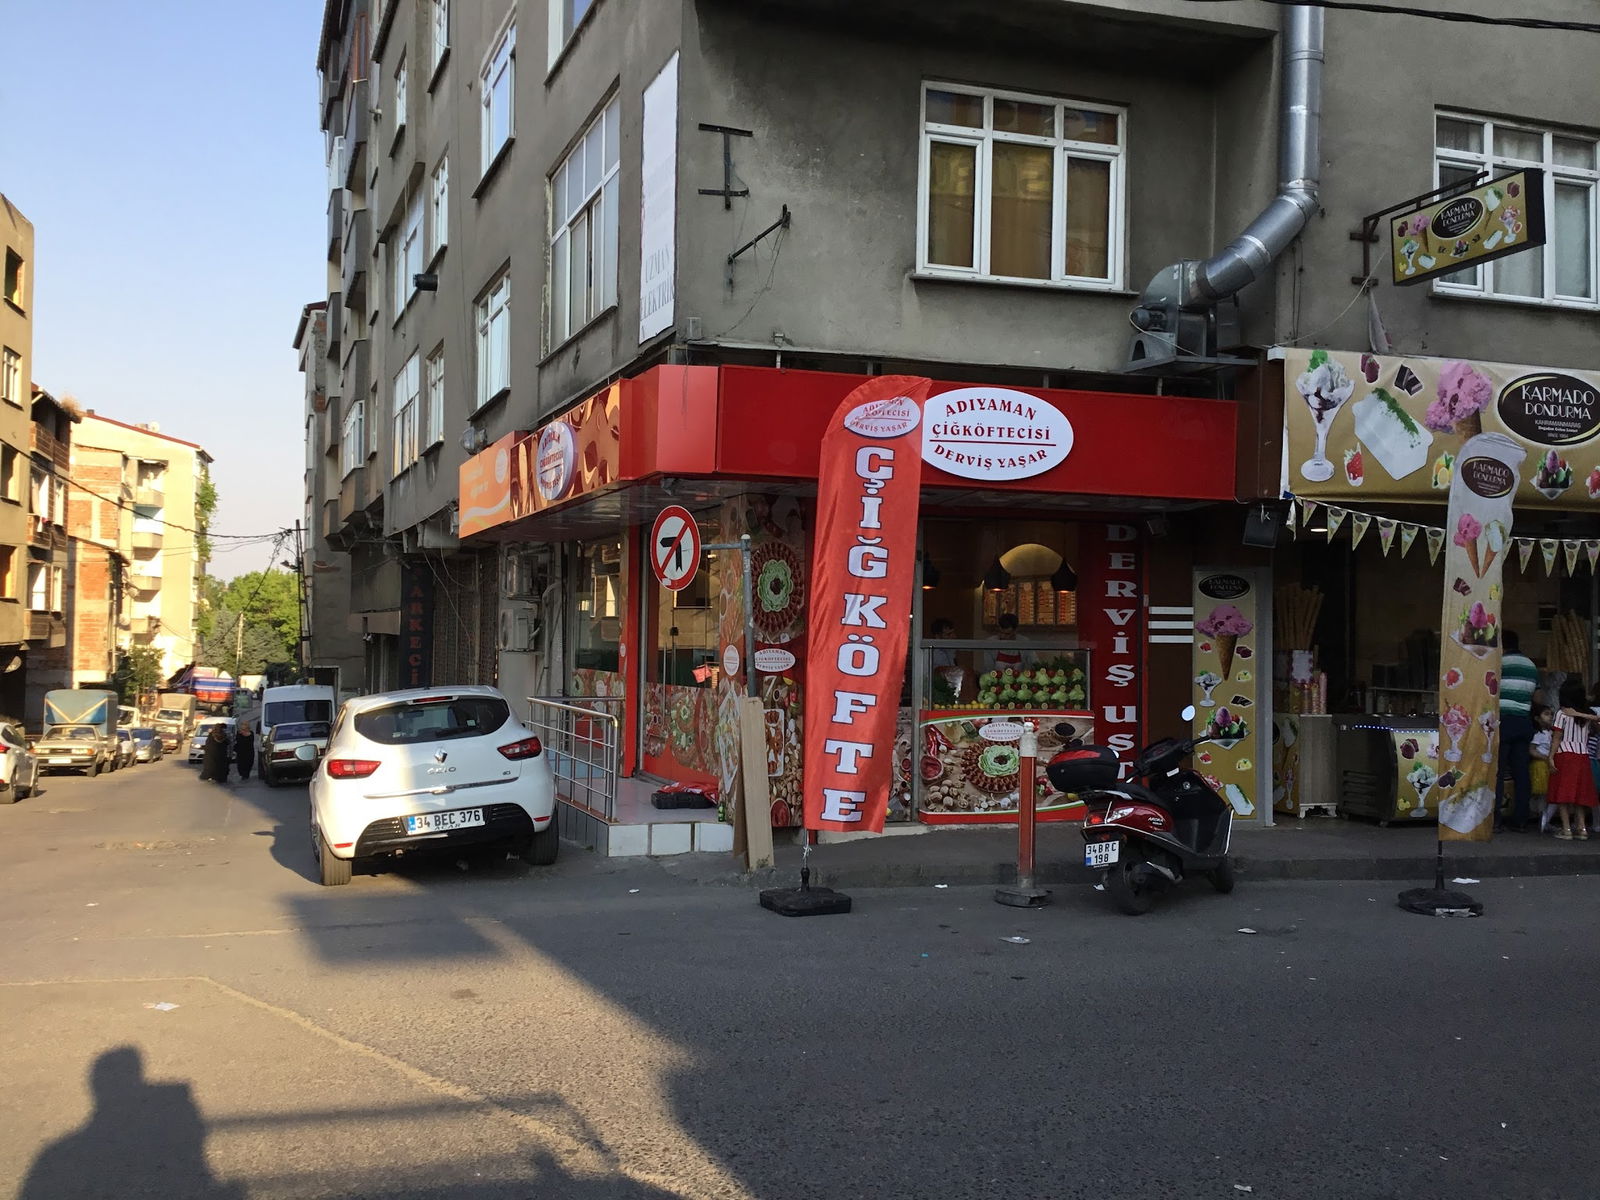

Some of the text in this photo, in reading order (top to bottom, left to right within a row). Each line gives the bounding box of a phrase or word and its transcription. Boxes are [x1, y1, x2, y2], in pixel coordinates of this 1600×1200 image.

[1521, 385, 1595, 406] KARMADO
[945, 398, 1037, 421] ADIYAMAN
[1525, 402, 1592, 420] DONDURMA
[932, 420, 1050, 440] ÇİĞKÖFTECİSİ
[934, 444, 1048, 470] DERVİŞ YAŞAR
[416, 810, 481, 829] 34 BEC 376
[1094, 853, 1109, 864] 198
